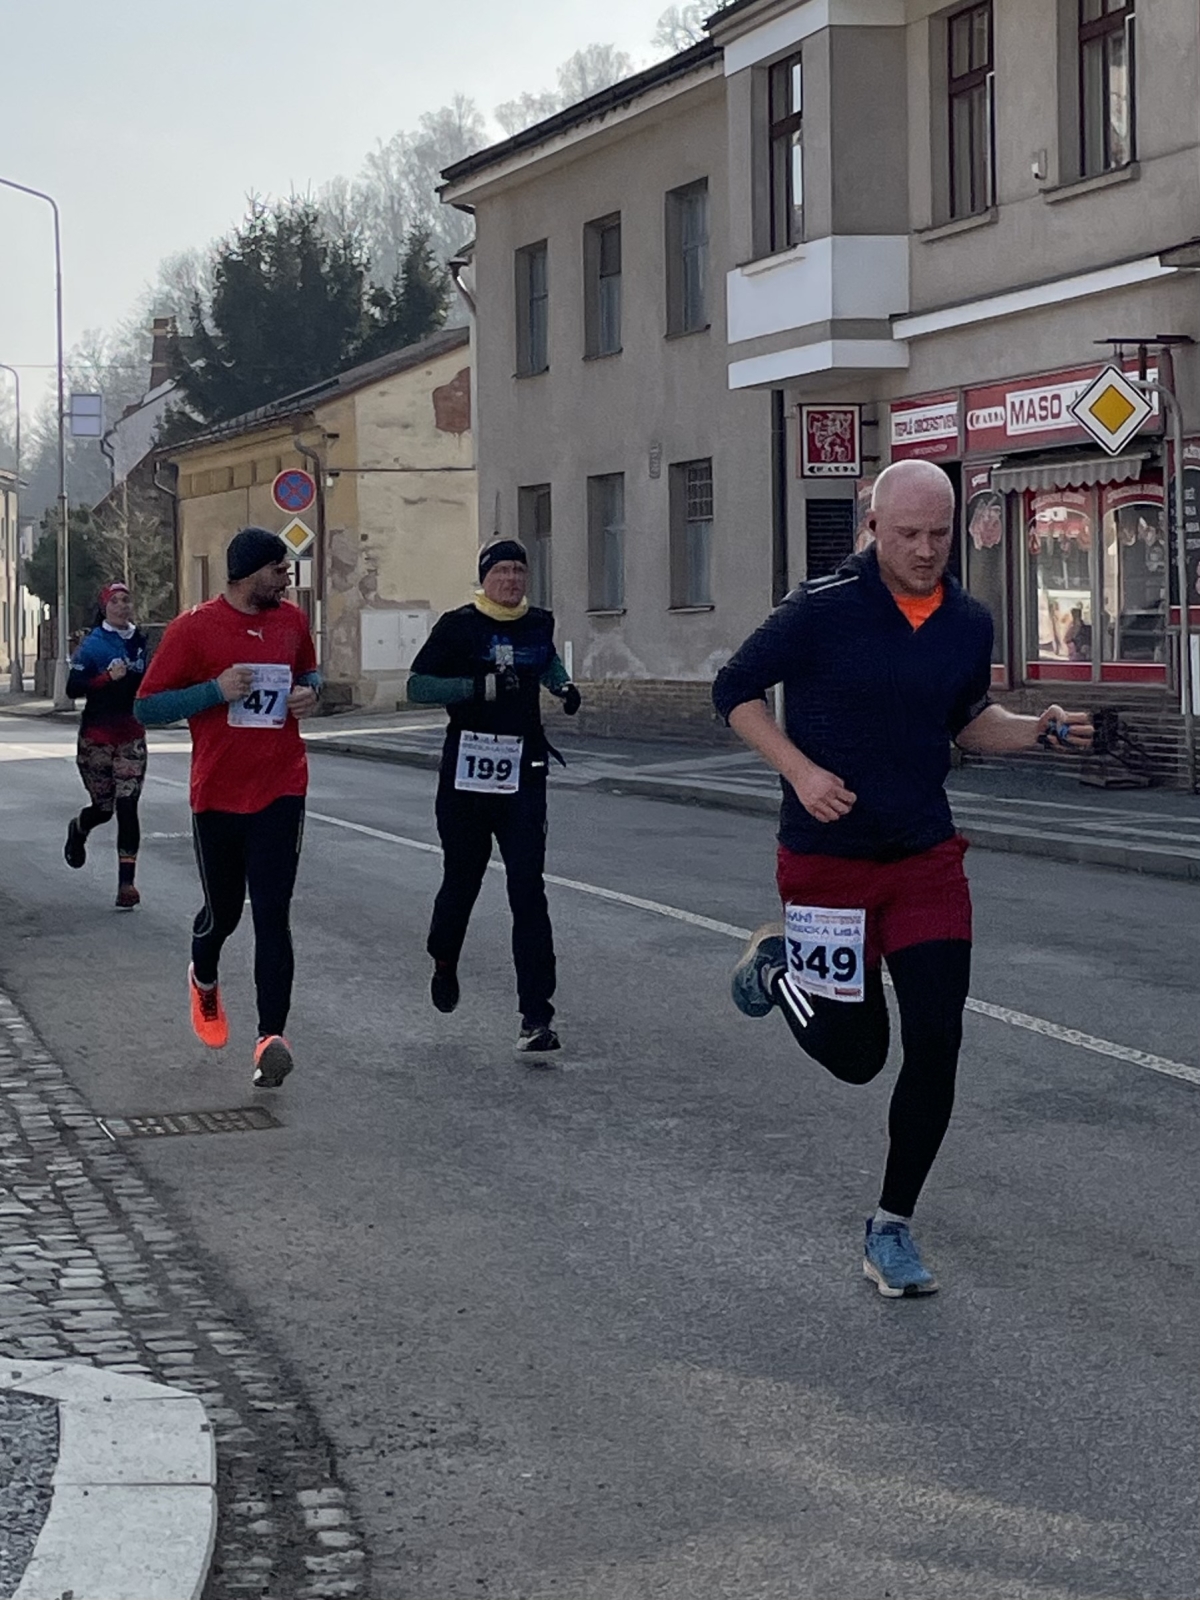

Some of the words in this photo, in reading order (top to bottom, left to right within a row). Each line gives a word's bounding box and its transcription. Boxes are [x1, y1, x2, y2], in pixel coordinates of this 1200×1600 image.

[1010, 393, 1062, 427] MASO
[243, 689, 279, 715] 47
[465, 755, 513, 782] 199
[787, 937, 858, 983] 349
